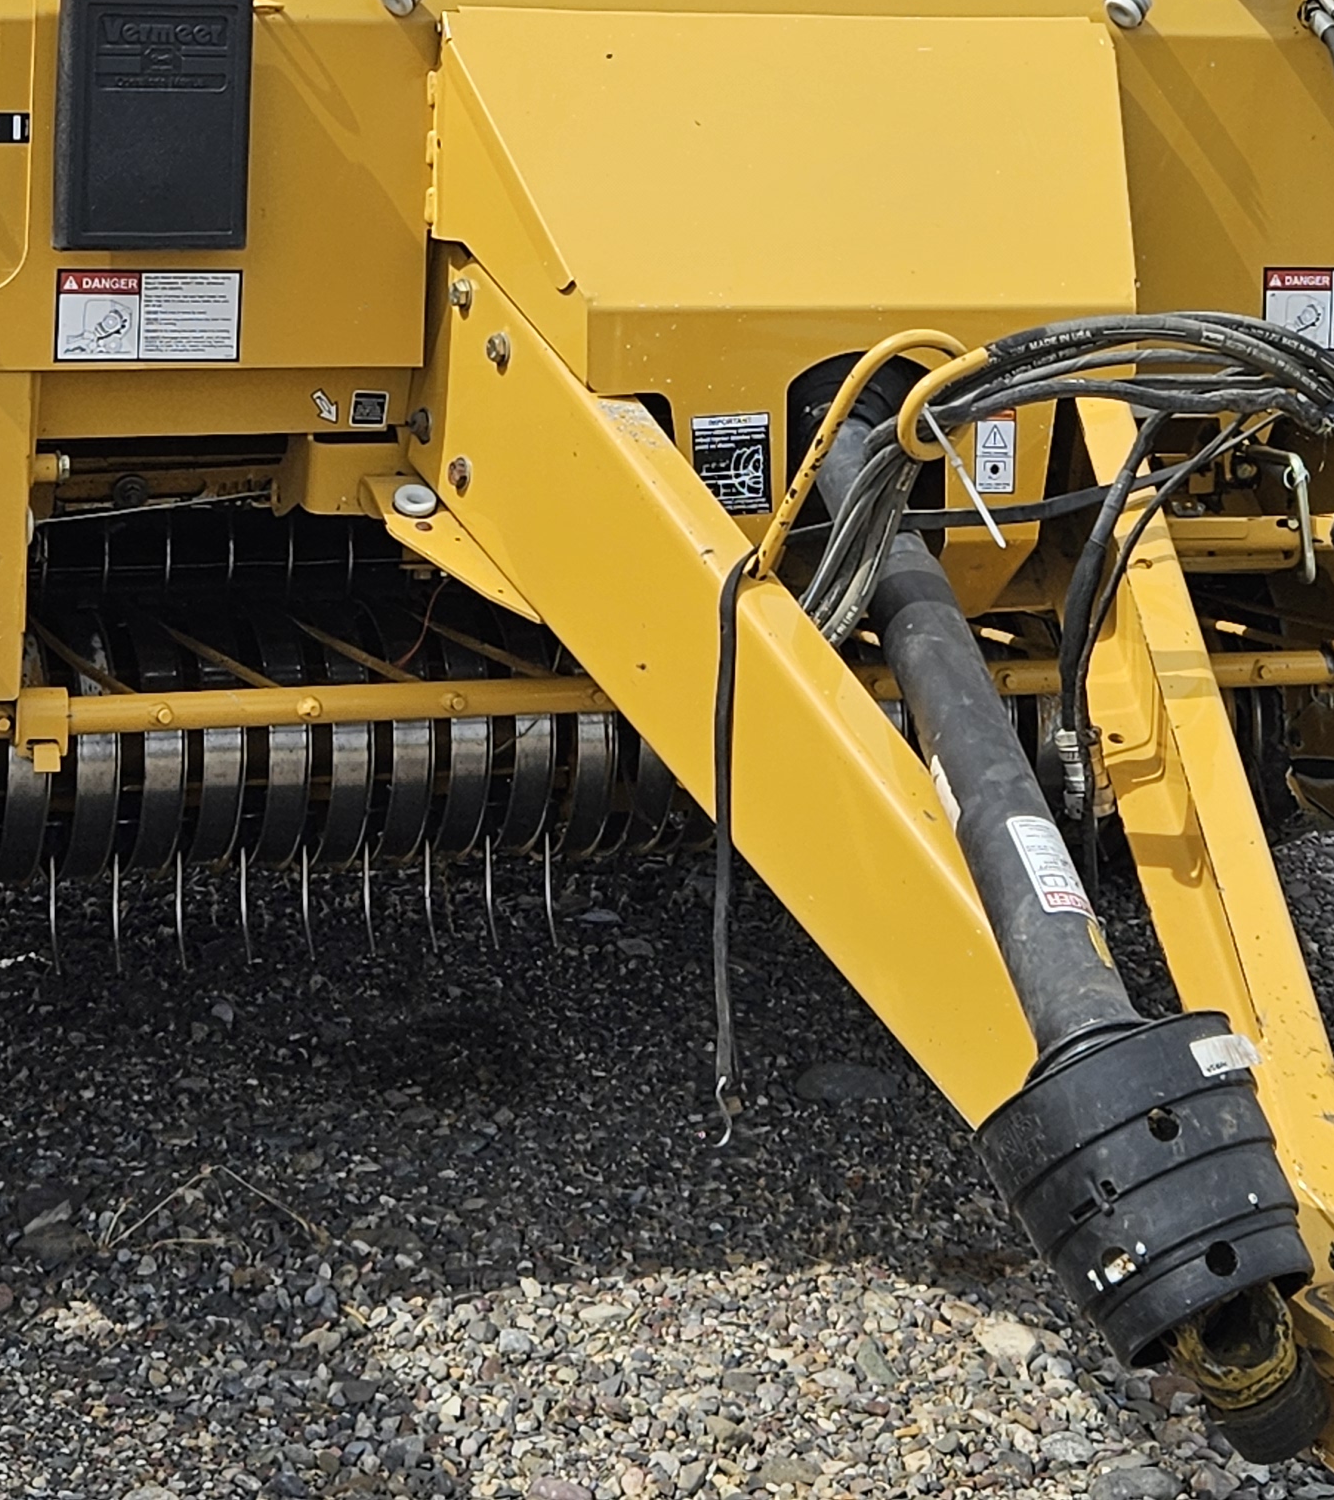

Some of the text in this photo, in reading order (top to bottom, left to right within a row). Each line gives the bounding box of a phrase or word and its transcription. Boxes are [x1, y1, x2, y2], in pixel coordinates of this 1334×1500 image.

[102, 17, 223, 45] Vermeer
[82, 276, 138, 290] DANGER
[1284, 274, 1331, 287] DANGER
[1028, 333, 1058, 351] MADE
[708, 417, 753, 427] IMPORTANT
